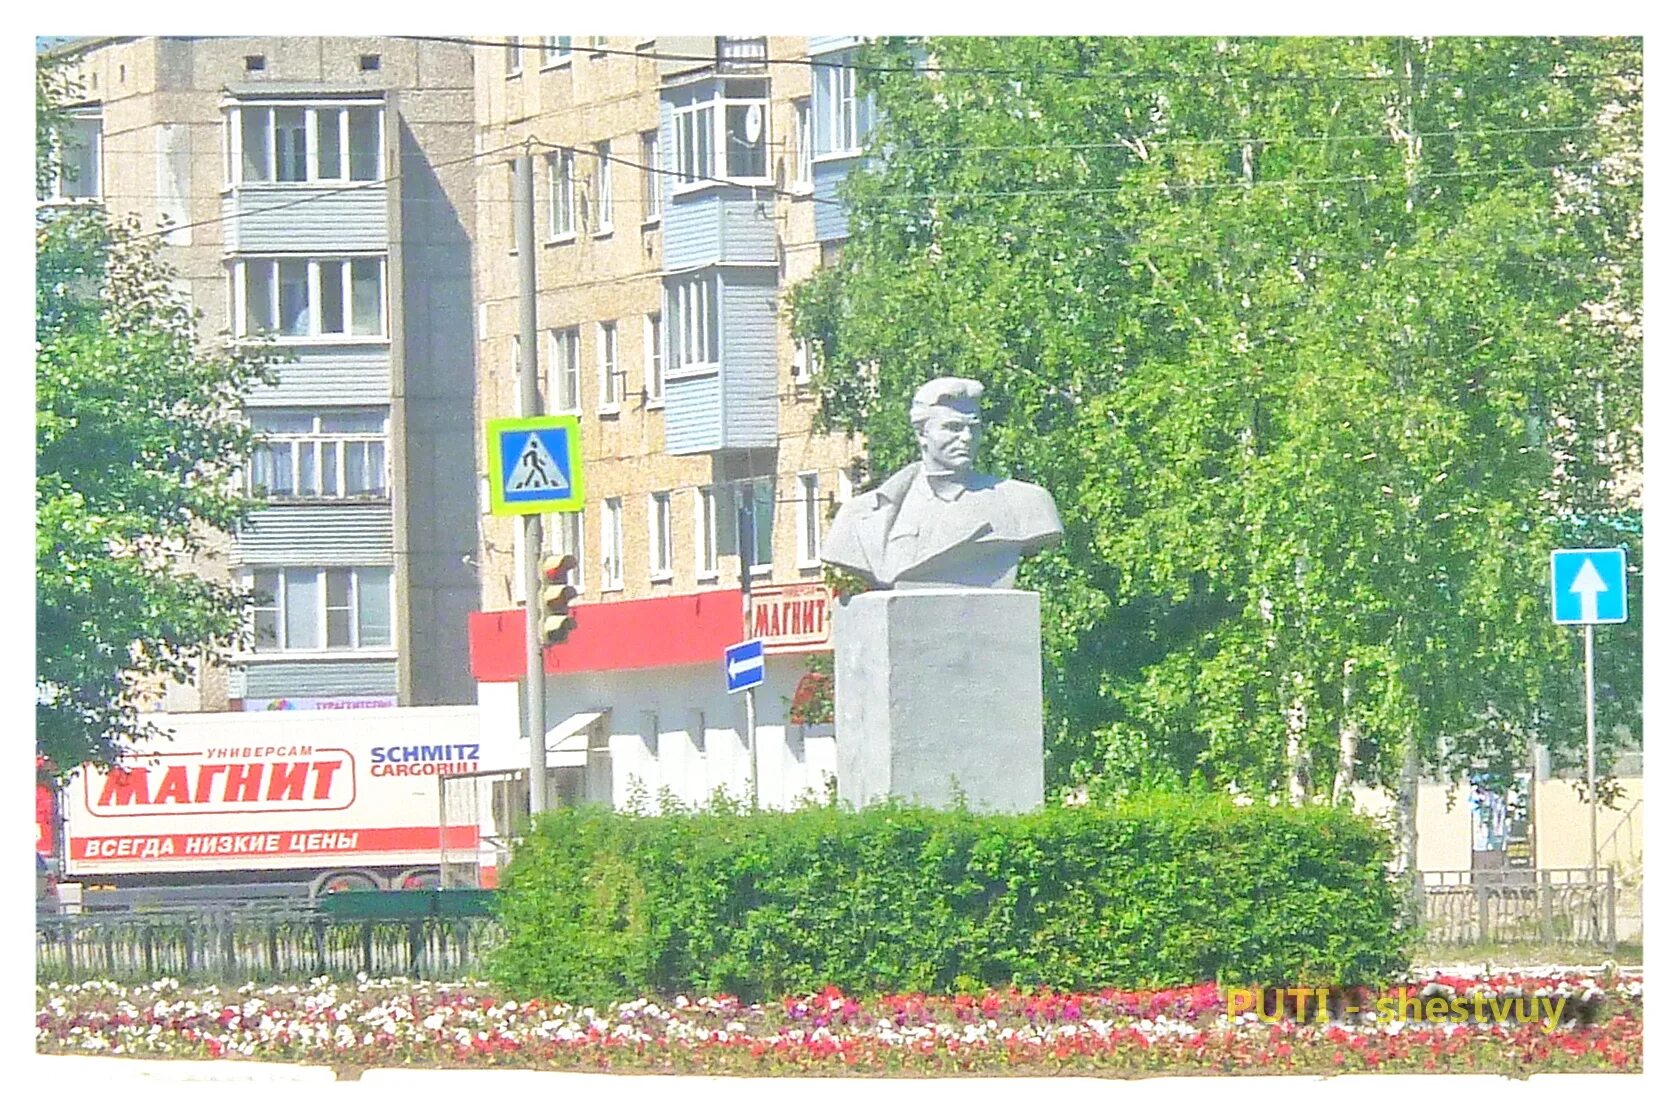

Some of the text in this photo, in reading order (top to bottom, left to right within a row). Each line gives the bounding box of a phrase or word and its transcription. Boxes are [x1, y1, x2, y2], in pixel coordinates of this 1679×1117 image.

[754, 600, 825, 637] МАГНИТ
[207, 746, 312, 759] УНИВЕРСАМ
[370, 744, 480, 763] SCHMITZ
[97, 761, 343, 806] МАГНИТ
[85, 832, 358, 858] ВСЕГДА НИЗКИЕ ЦЕНЫ
